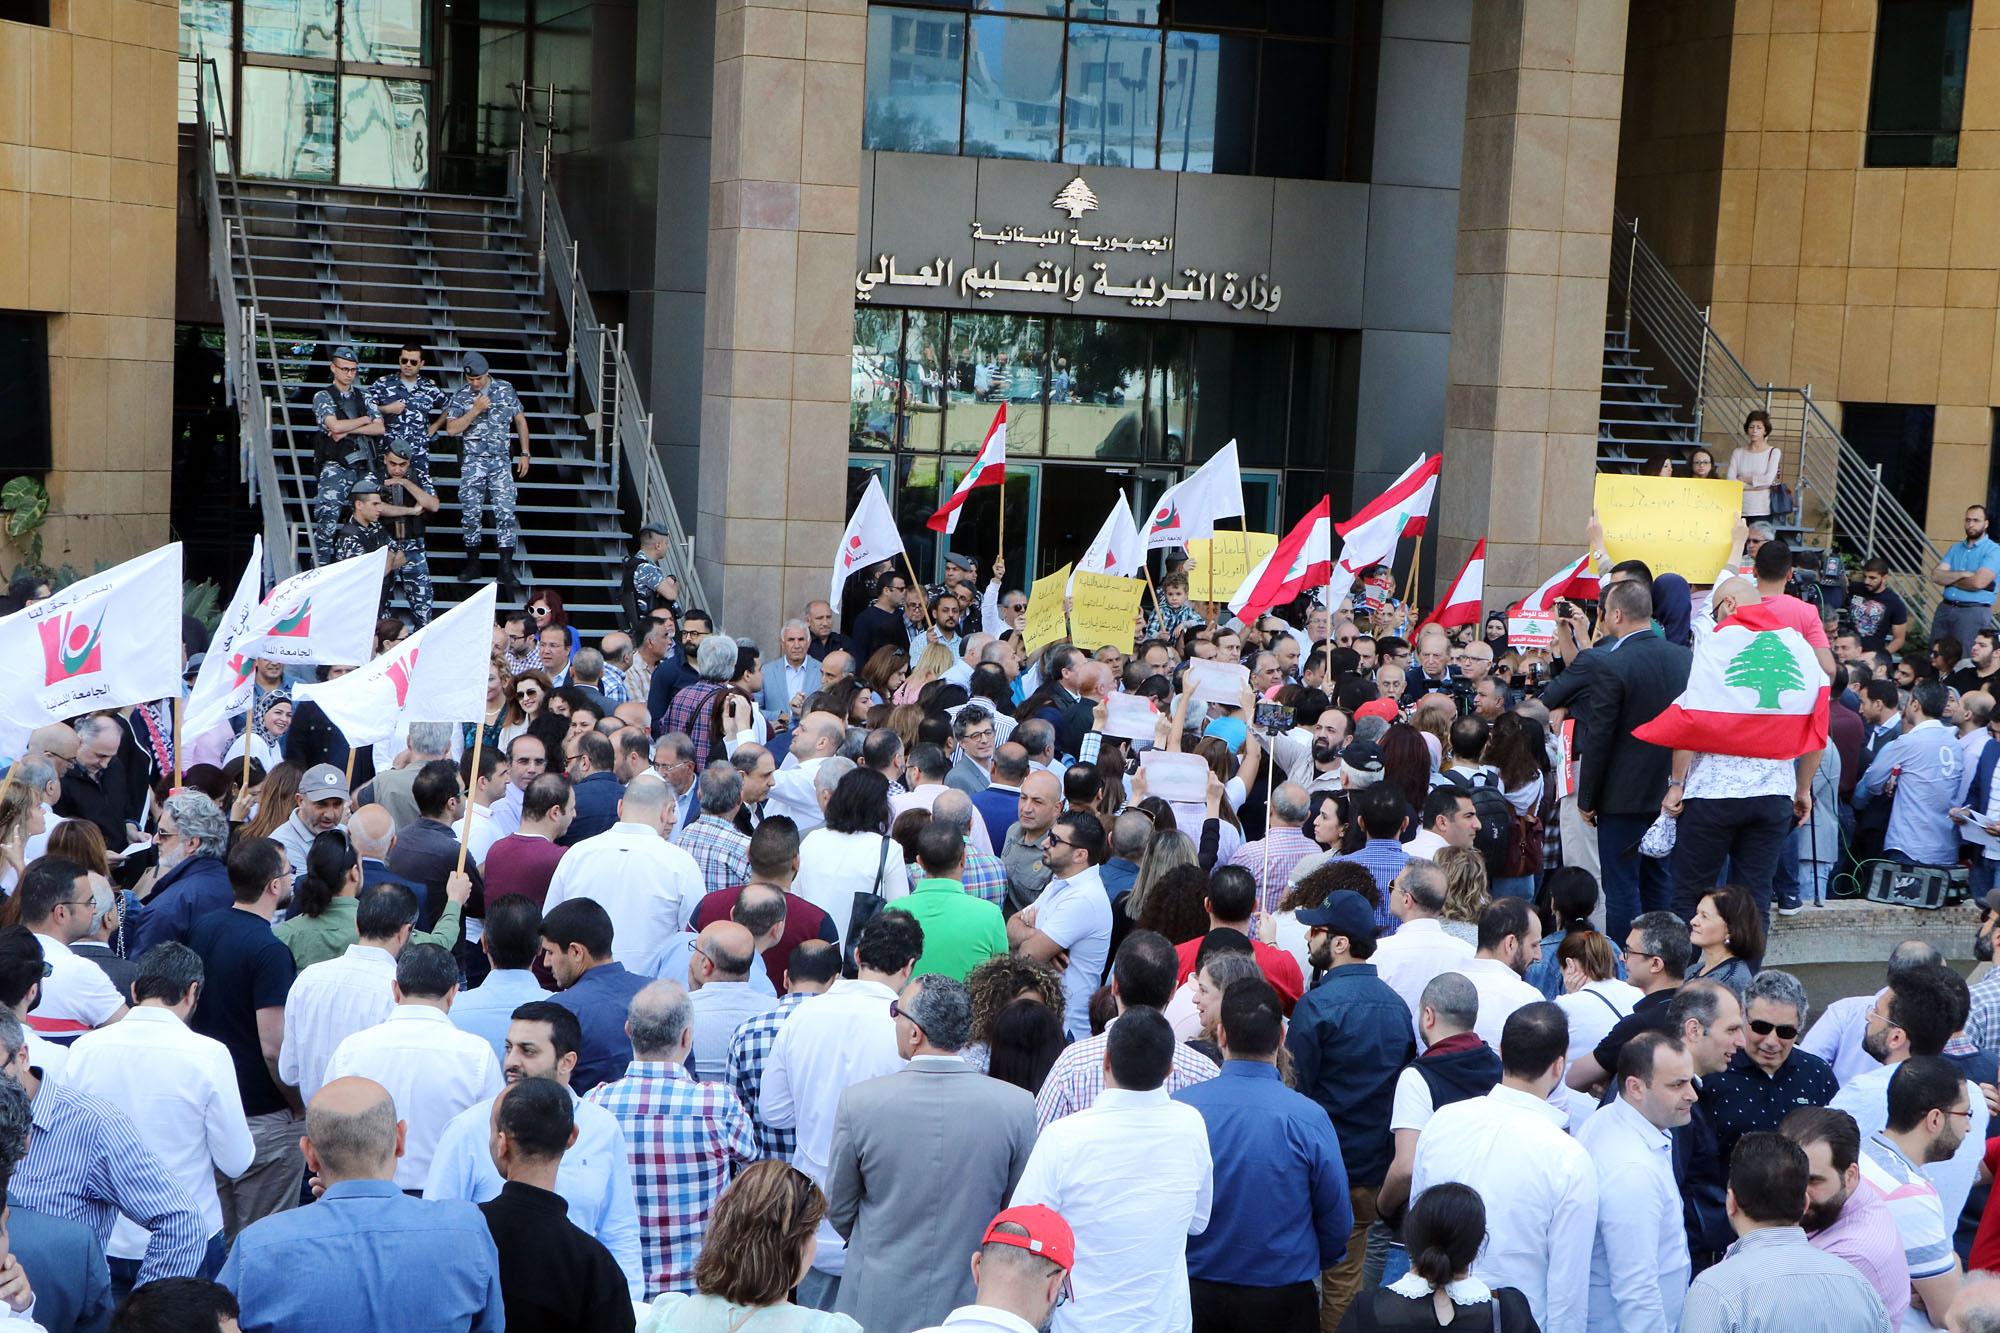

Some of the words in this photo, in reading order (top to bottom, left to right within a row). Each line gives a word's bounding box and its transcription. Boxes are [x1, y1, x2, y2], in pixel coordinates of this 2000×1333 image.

[970, 222, 1066, 248] اللبنانية
[1070, 228, 1174, 255] الجمهورية
[855, 254, 953, 300] العالي
[961, 260, 1087, 302] والتعليم
[1092, 262, 1216, 307] التربية
[1221, 271, 1282, 312] وزارة
[280, 646, 313, 658] الجامعة
[71, 684, 111, 701] الجامعة
[1939, 746, 1955, 776] 9
